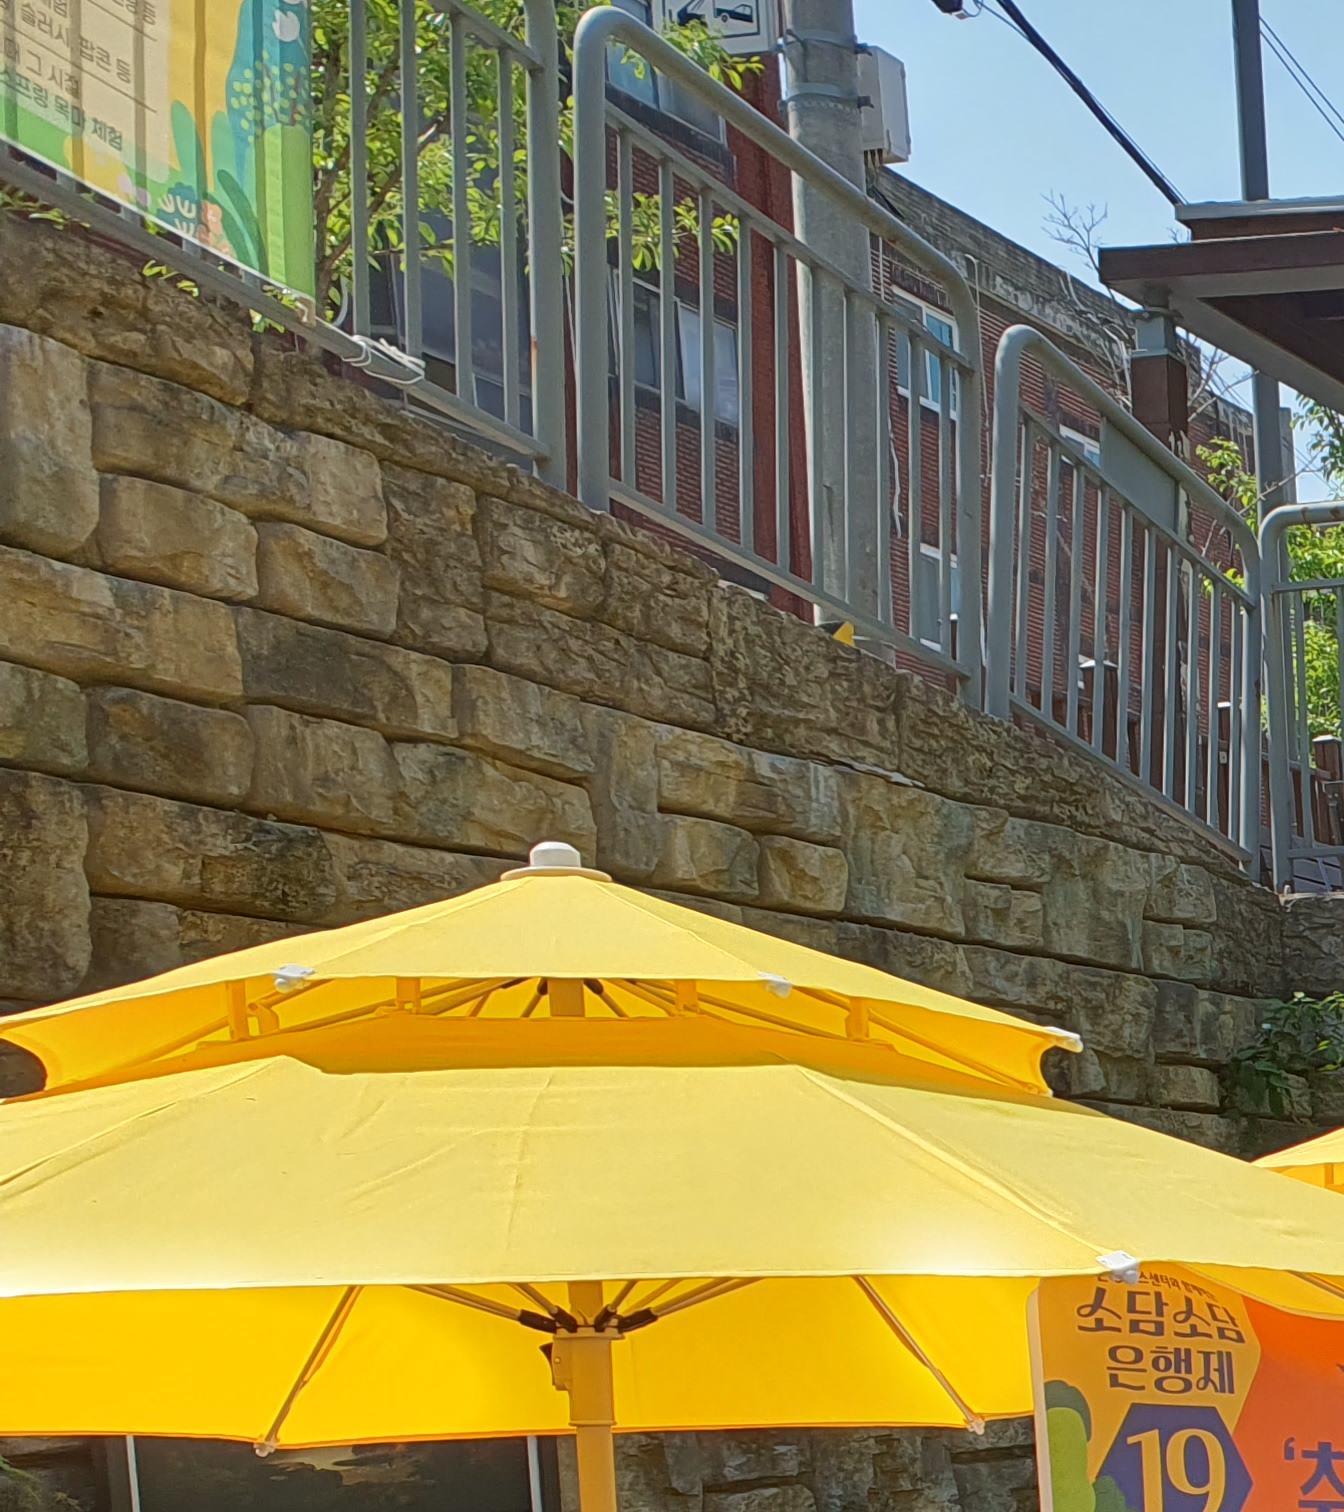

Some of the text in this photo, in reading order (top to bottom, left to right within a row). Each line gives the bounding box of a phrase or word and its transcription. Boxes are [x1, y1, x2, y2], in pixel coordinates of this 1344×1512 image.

[25, 49, 42, 76] 그
[79, 35, 112, 72] 팝콘
[116, 58, 131, 84] 등
[91, 116, 123, 151] 체험
[1076, 1286, 1246, 1344] 소담소담
[1106, 1345, 1236, 1394] 은행제
